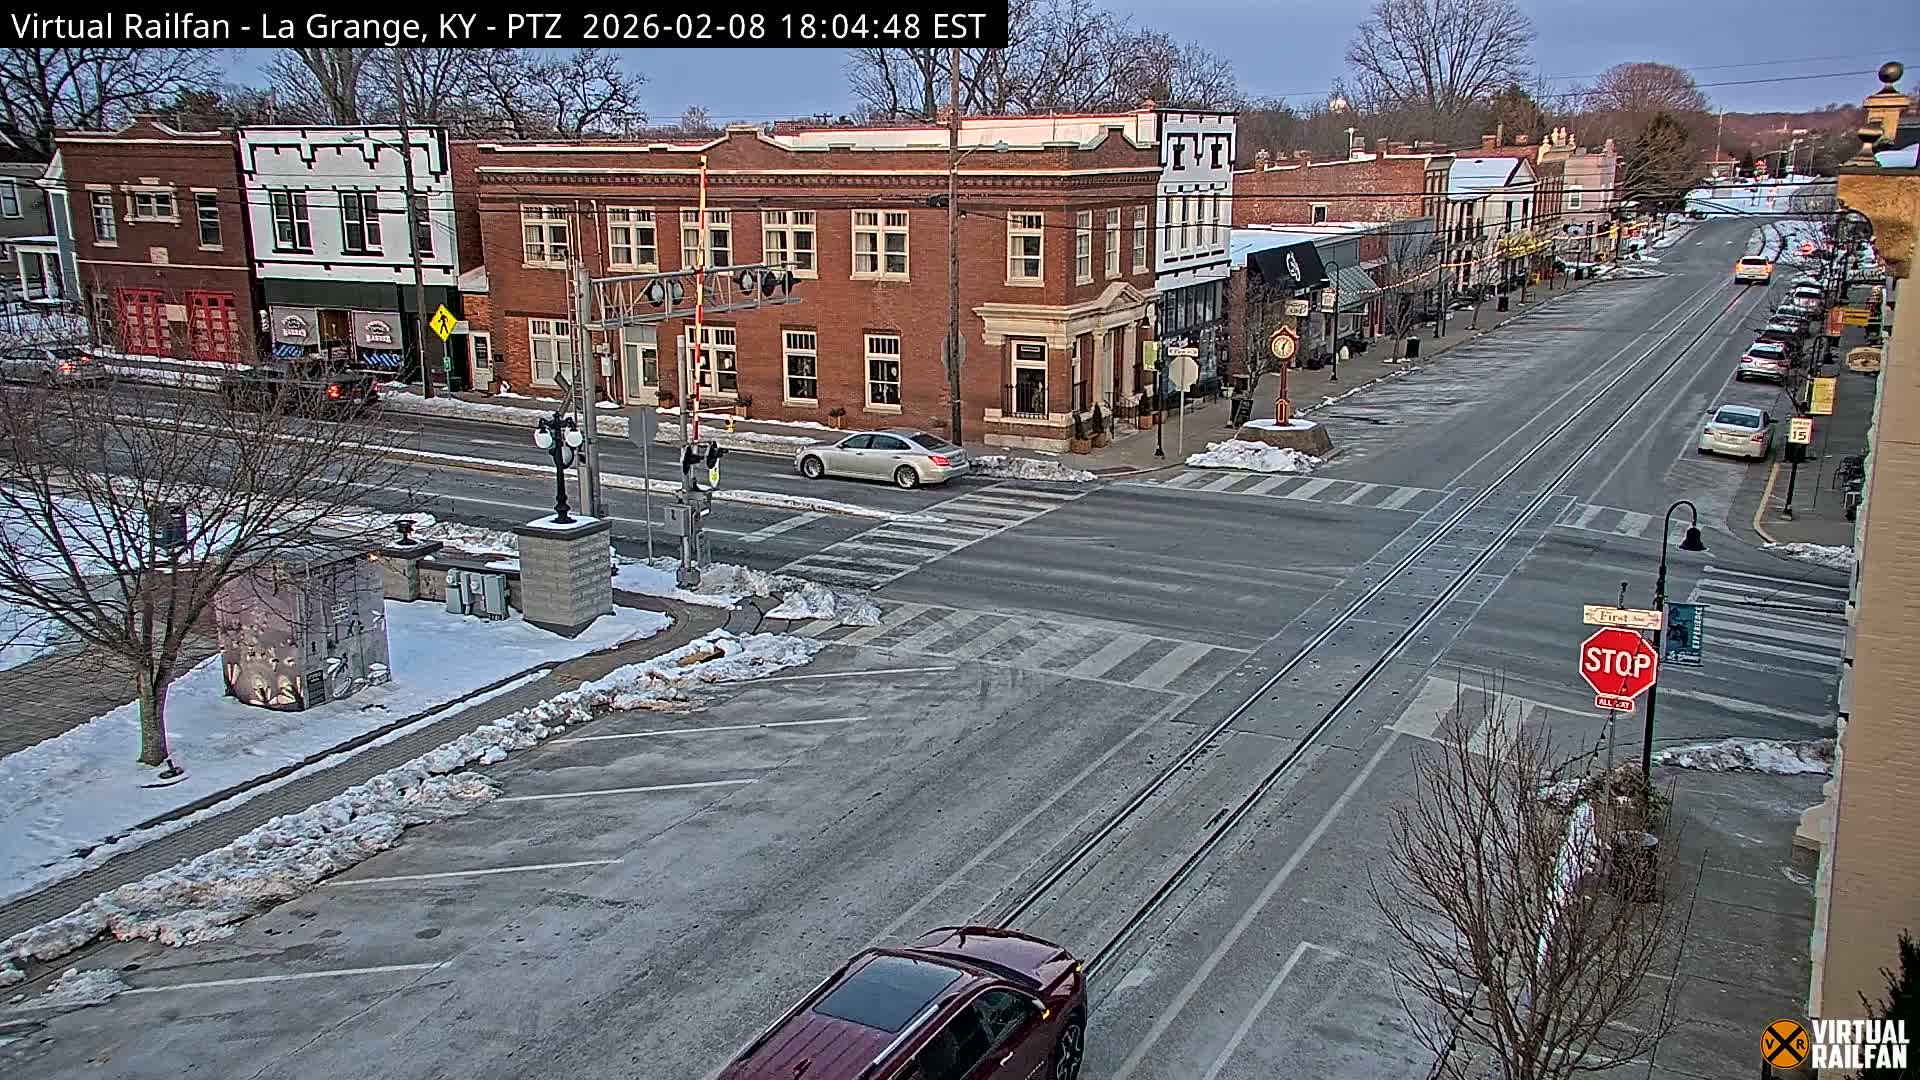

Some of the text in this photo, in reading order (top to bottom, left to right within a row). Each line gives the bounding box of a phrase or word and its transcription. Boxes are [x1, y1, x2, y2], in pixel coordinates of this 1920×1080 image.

[1793, 431, 1807, 441] 15
[1600, 610, 1628, 622] First
[1584, 646, 1652, 678] STOP
[1598, 698, 1612, 707] ALL
